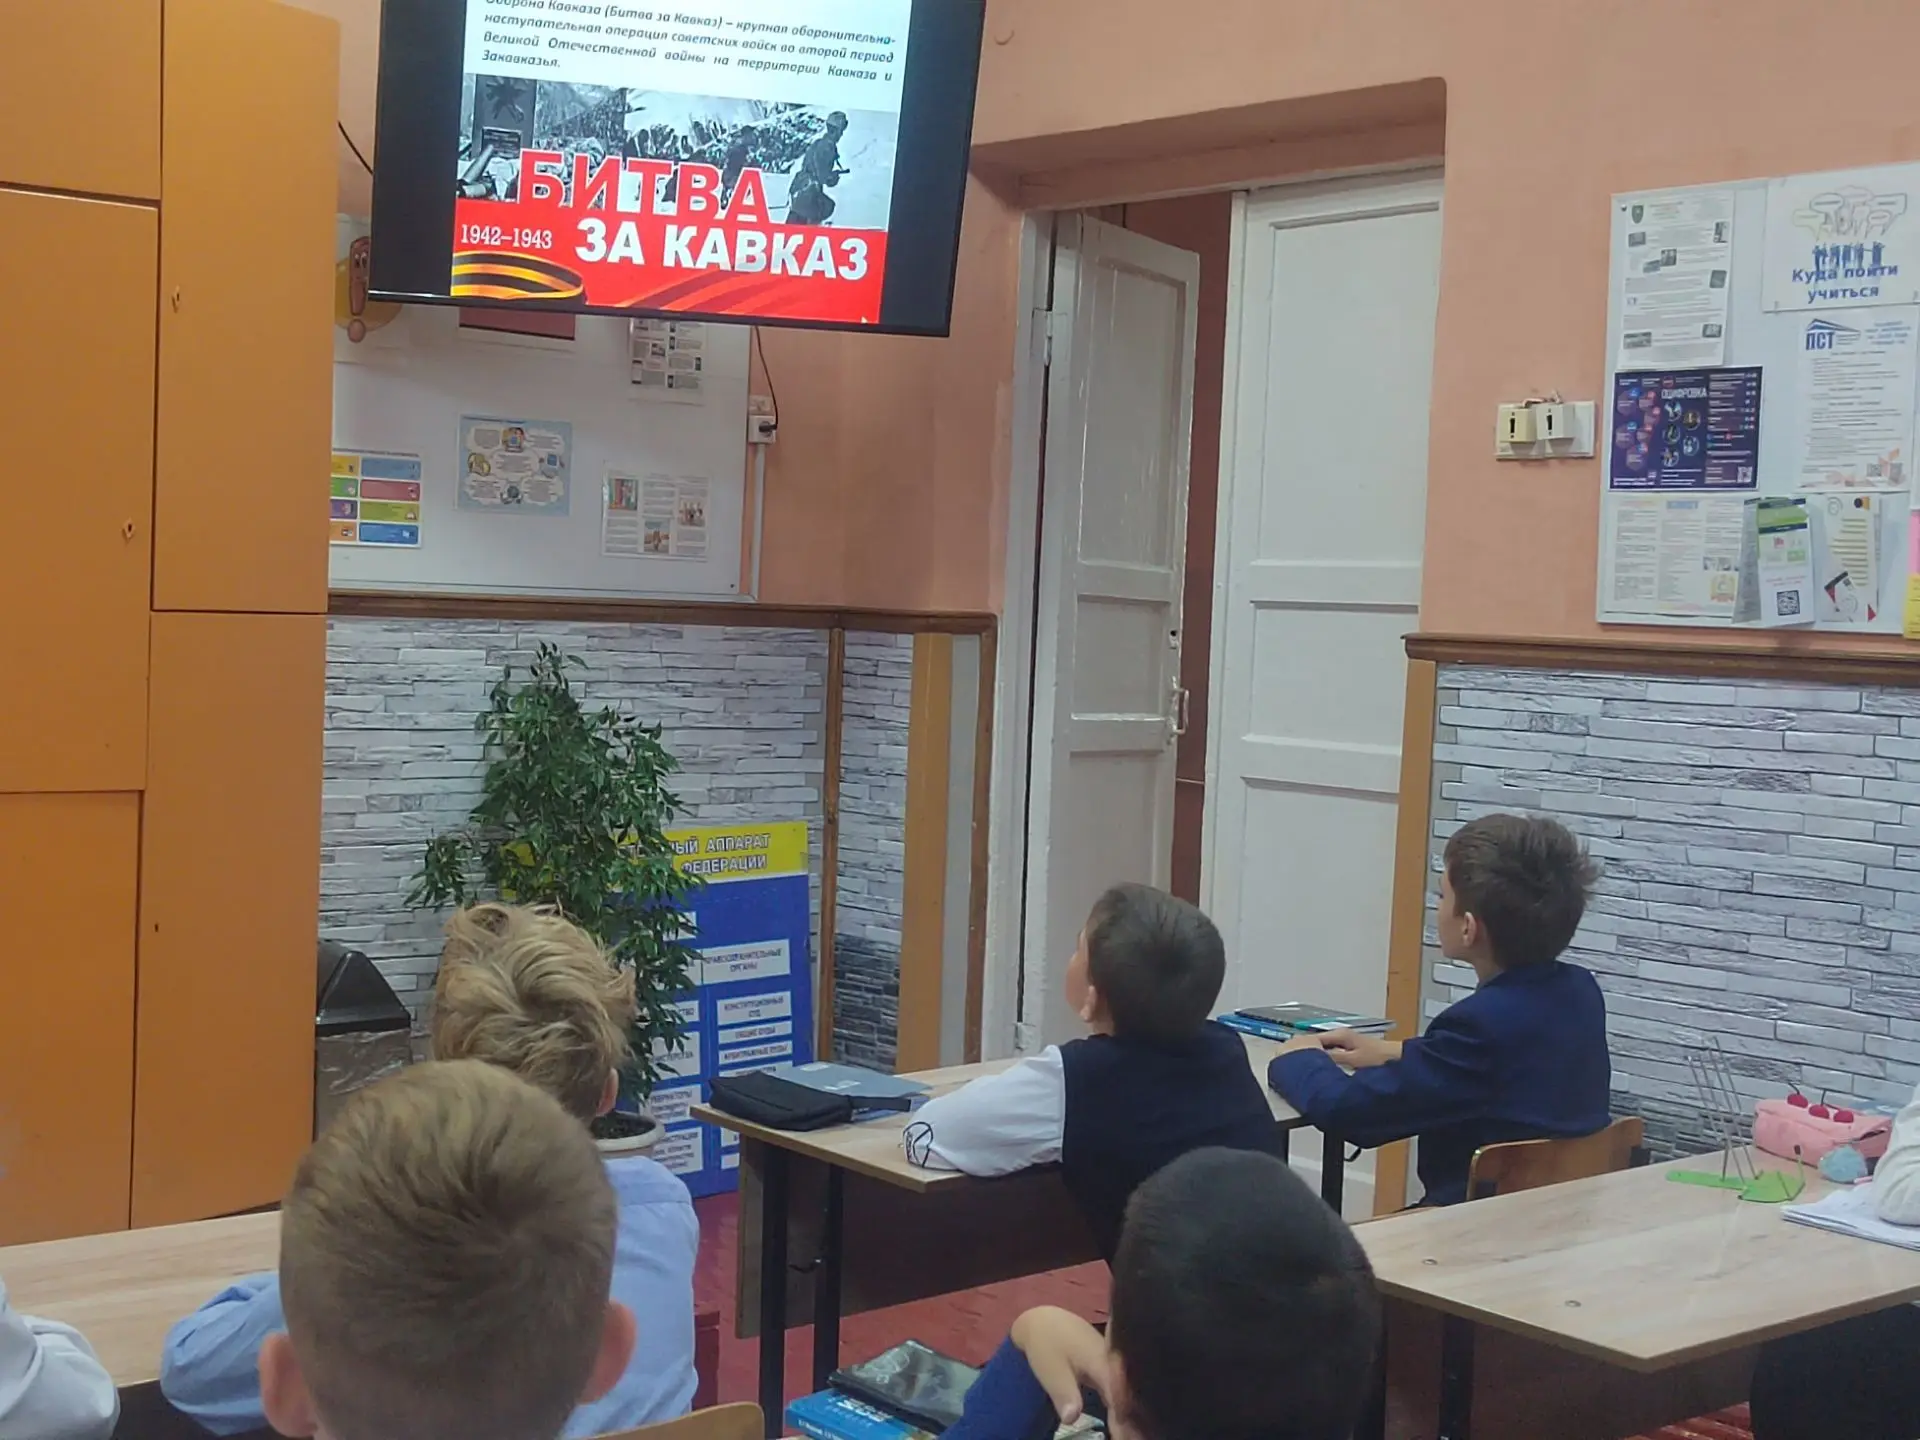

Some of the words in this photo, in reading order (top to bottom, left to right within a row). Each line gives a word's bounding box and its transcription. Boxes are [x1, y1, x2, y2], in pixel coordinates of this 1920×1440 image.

[548, 0, 602, 15] Кавказа
[604, 5, 654, 21] (Битва
[656, 13, 671, 22] за
[674, 12, 723, 29] Кавказ)
[736, 21, 788, 34] крупная
[791, 25, 896, 45] оборонительно-
[484, 14, 602, 33] наступательная
[605, 27, 669, 42] операция
[671, 32, 738, 47] советских
[742, 39, 777, 52] войск
[780, 43, 795, 53] во
[798, 46, 847, 59] второй
[850, 50, 894, 63] период
[482, 49, 561, 68] Закавказья.
[483, 31, 540, 47] Великой
[548, 37, 657, 58] Отечественной
[664, 50, 706, 63] войны
[713, 56, 730, 66] на
[737, 58, 821, 75] территории
[827, 64, 878, 80] Кавказа
[884, 72, 893, 81] и
[517, 149, 775, 224] БИТВА
[575, 217, 646, 266] ЗА
[662, 223, 869, 281] КАВКАЗ
[1792, 267, 1838, 284] Куда
[1808, 286, 1880, 304] учиться
[1805, 331, 1836, 351] ПСТ
[705, 833, 771, 853] АППАРАТ
[682, 855, 768, 873] ФЕДЕРАЦИИ
